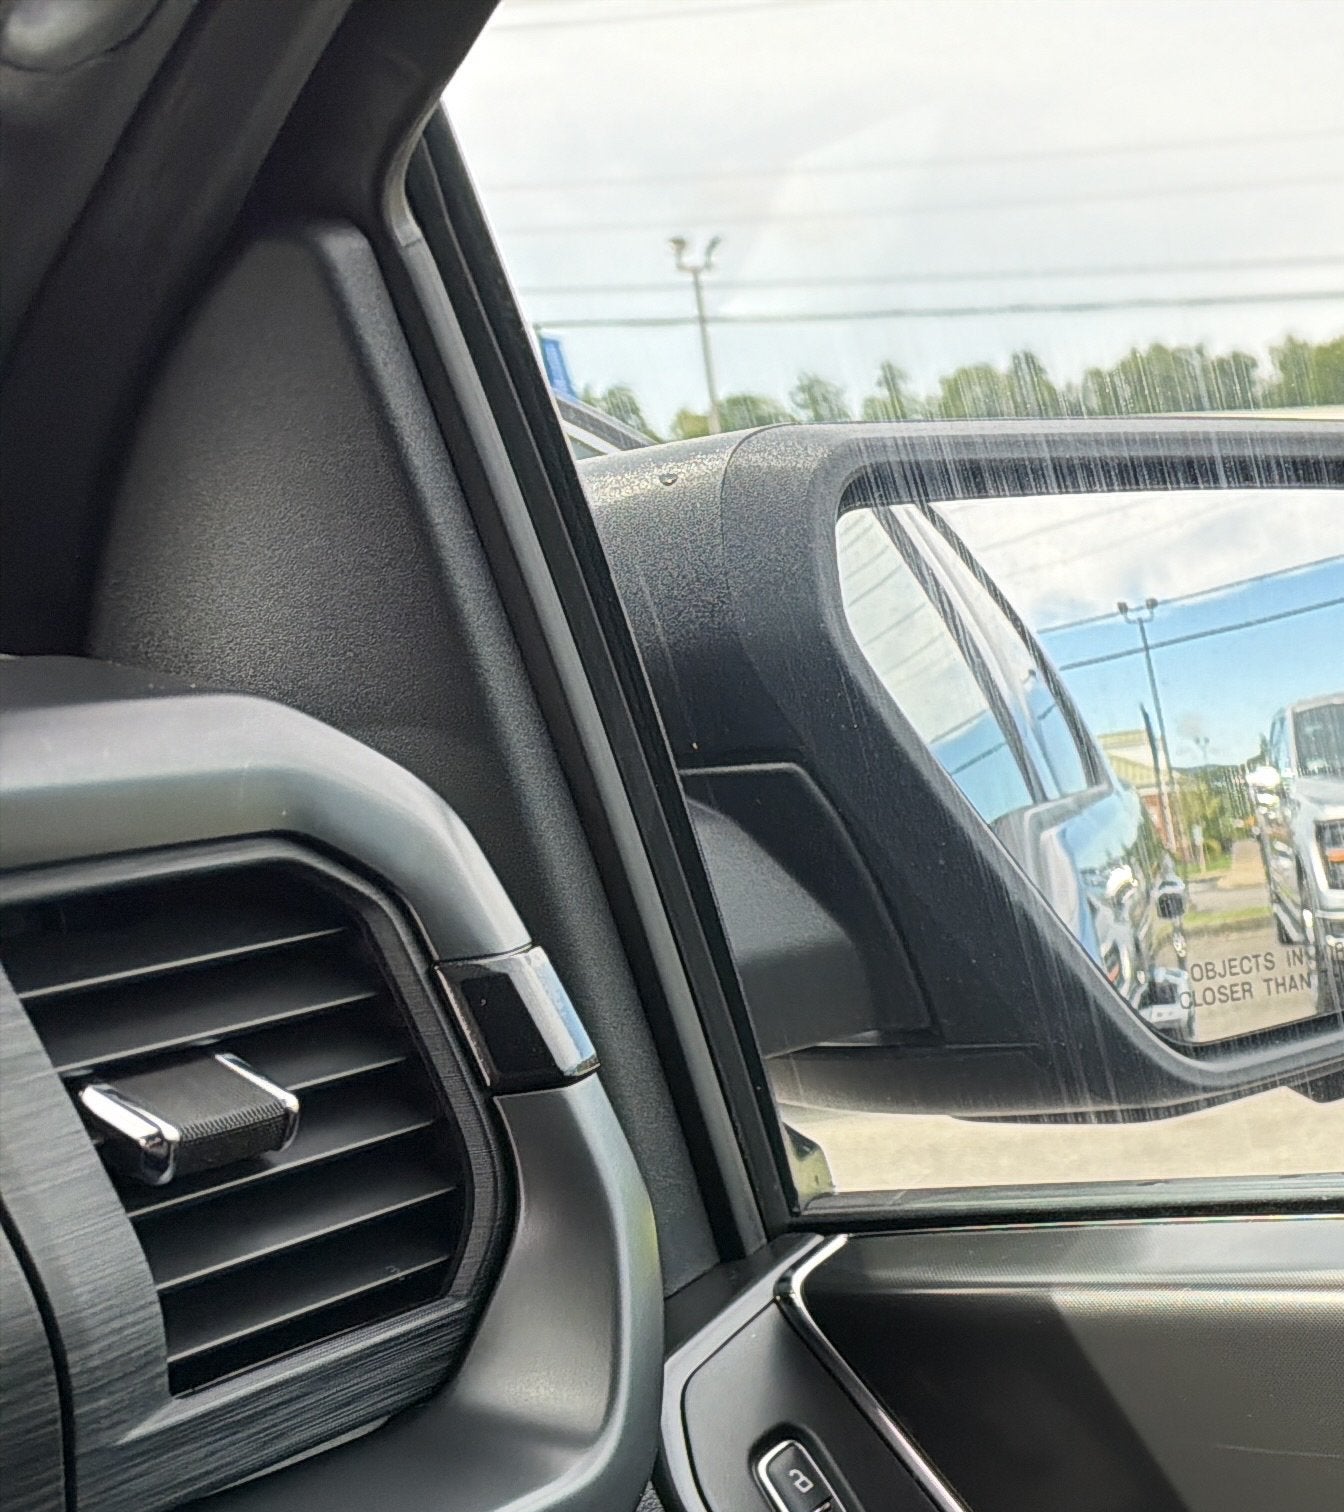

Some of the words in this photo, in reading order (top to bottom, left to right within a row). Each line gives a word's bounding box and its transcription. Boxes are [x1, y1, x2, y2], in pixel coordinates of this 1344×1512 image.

[1190, 952, 1276, 983] OBJECTS
[1287, 950, 1304, 967] IN
[1180, 981, 1254, 1010] CLOSER
[1263, 974, 1312, 997] THAN
